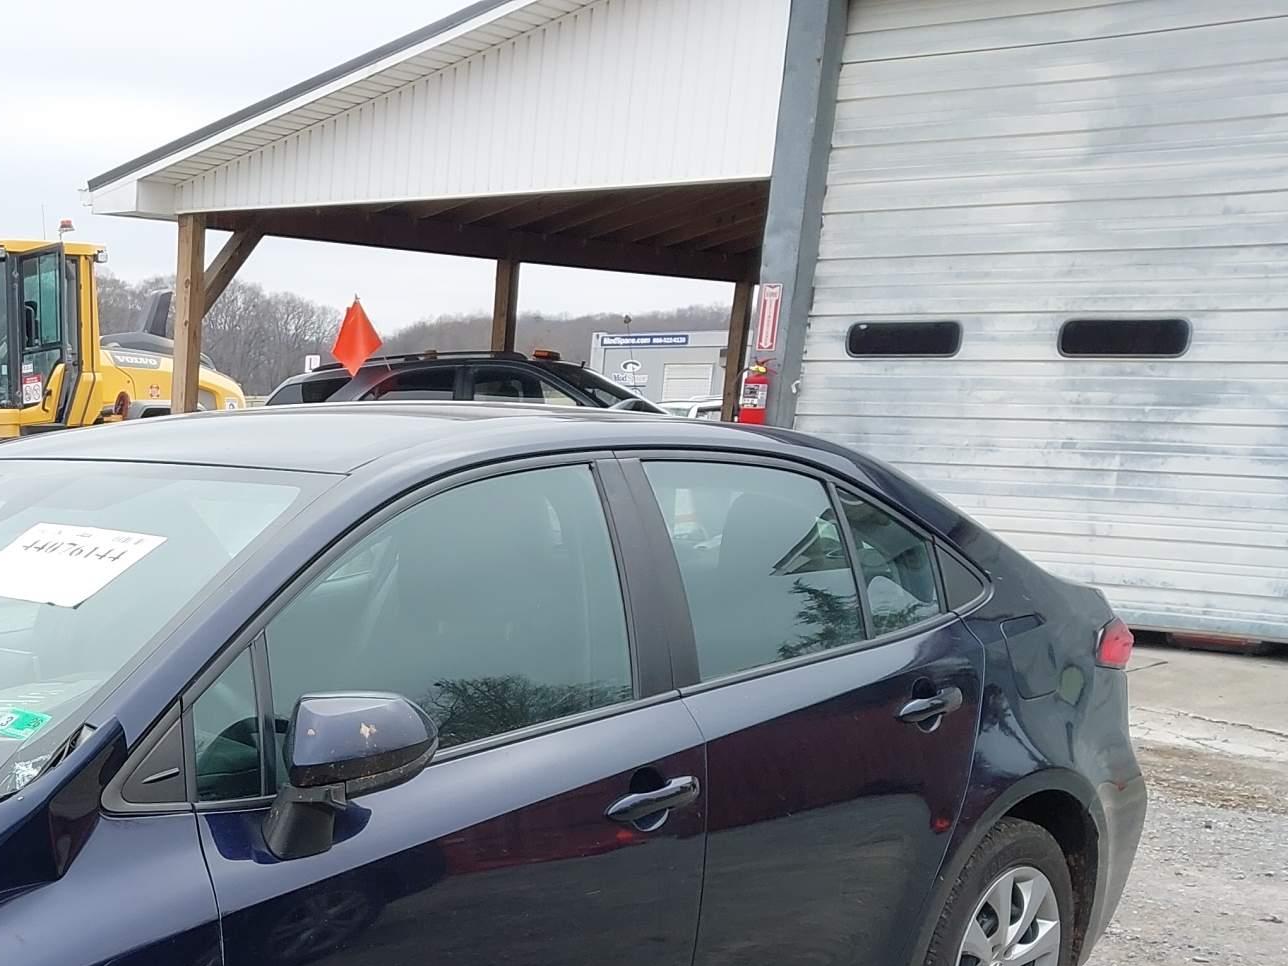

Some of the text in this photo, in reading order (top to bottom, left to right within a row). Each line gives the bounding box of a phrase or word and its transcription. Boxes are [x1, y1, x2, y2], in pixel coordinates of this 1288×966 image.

[113, 355, 158, 366] VOLVO
[22, 540, 128, 562] 44076144
[0, 716, 14, 727] 3
